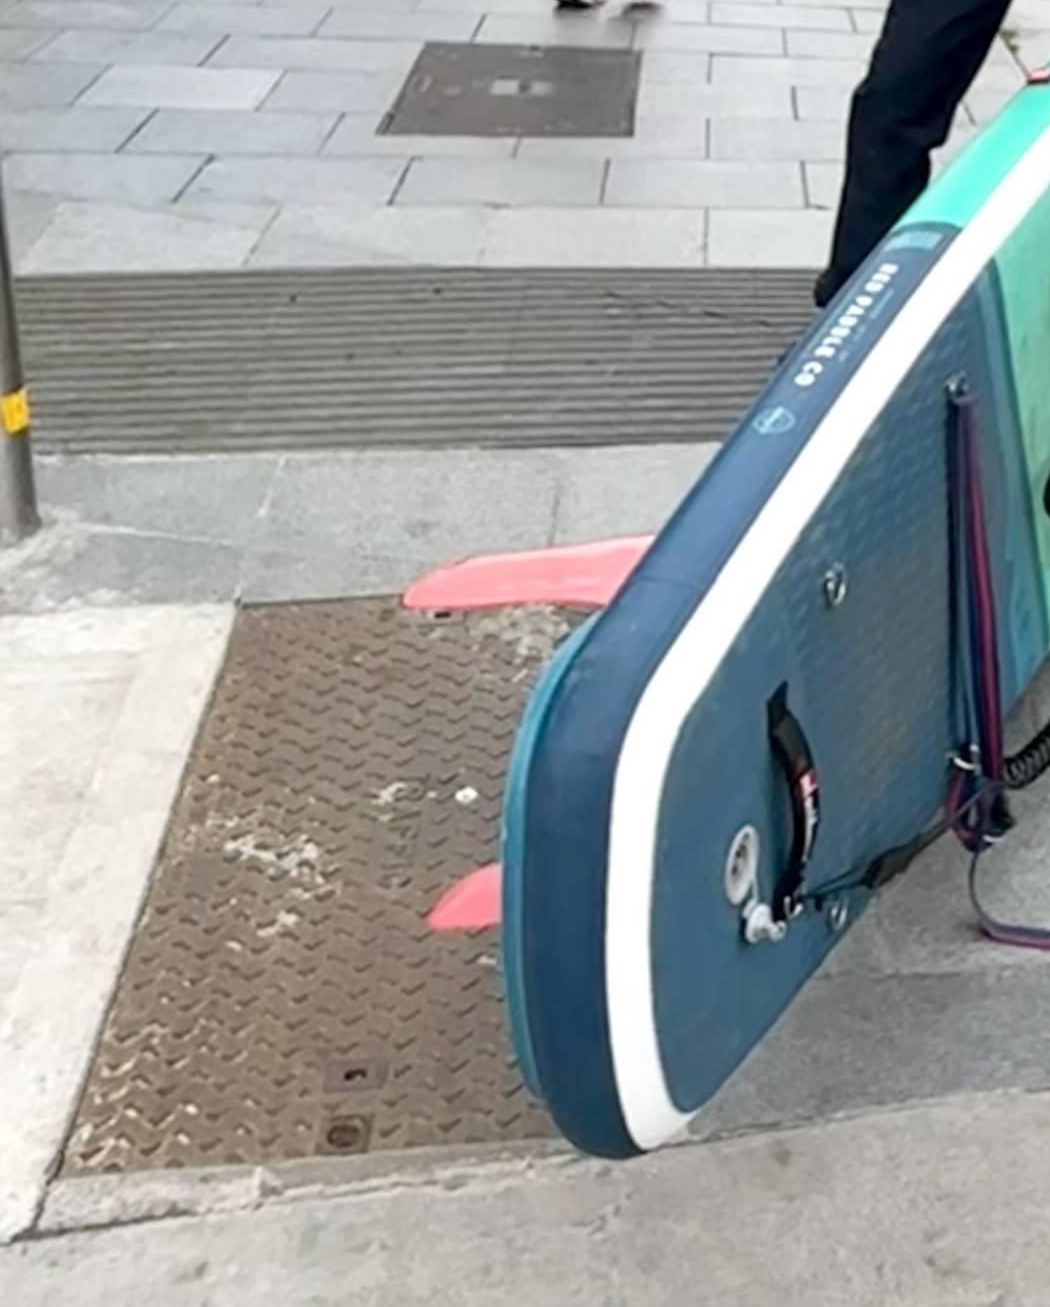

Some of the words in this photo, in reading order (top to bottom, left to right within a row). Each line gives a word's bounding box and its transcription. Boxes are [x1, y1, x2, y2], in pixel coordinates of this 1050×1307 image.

[864, 263, 899, 293] RED
[814, 295, 873, 358] PADDLE
[794, 361, 824, 387] CO
